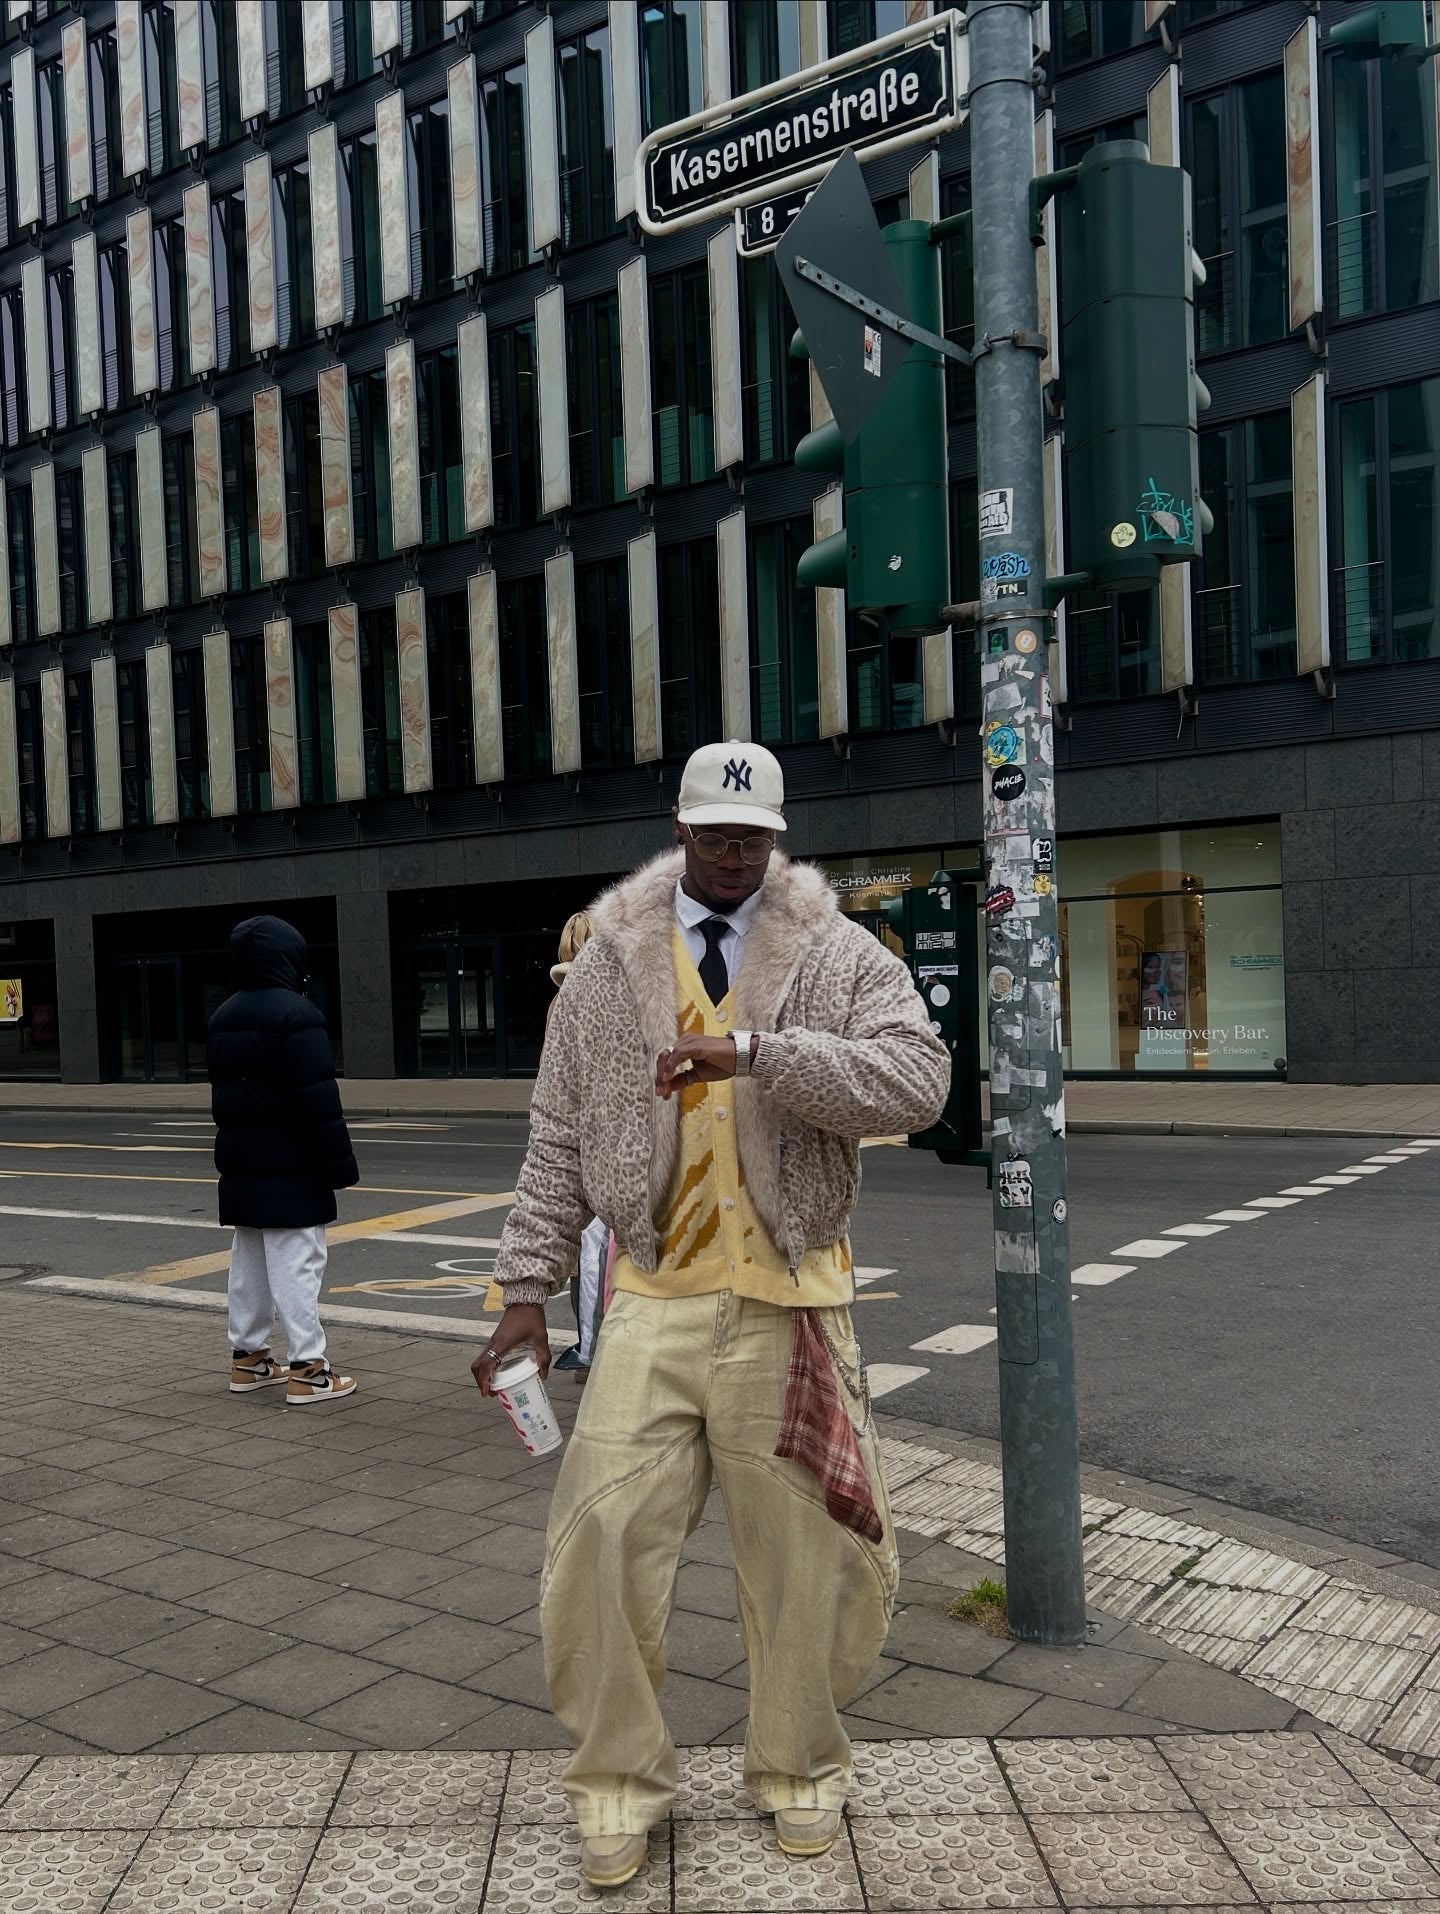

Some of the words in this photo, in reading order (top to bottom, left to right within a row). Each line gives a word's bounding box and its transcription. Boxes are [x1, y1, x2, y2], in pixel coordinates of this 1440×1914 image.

[669, 67, 920, 195] Kasernenstraße
[761, 206, 775, 234] 8
[722, 758, 753, 792] NY
[830, 873, 912, 888] SCHRAMMEK
[1143, 1006, 1177, 1021] The
[1146, 1025, 1230, 1044] Discovery
[1234, 1024, 1270, 1040] Bar.
